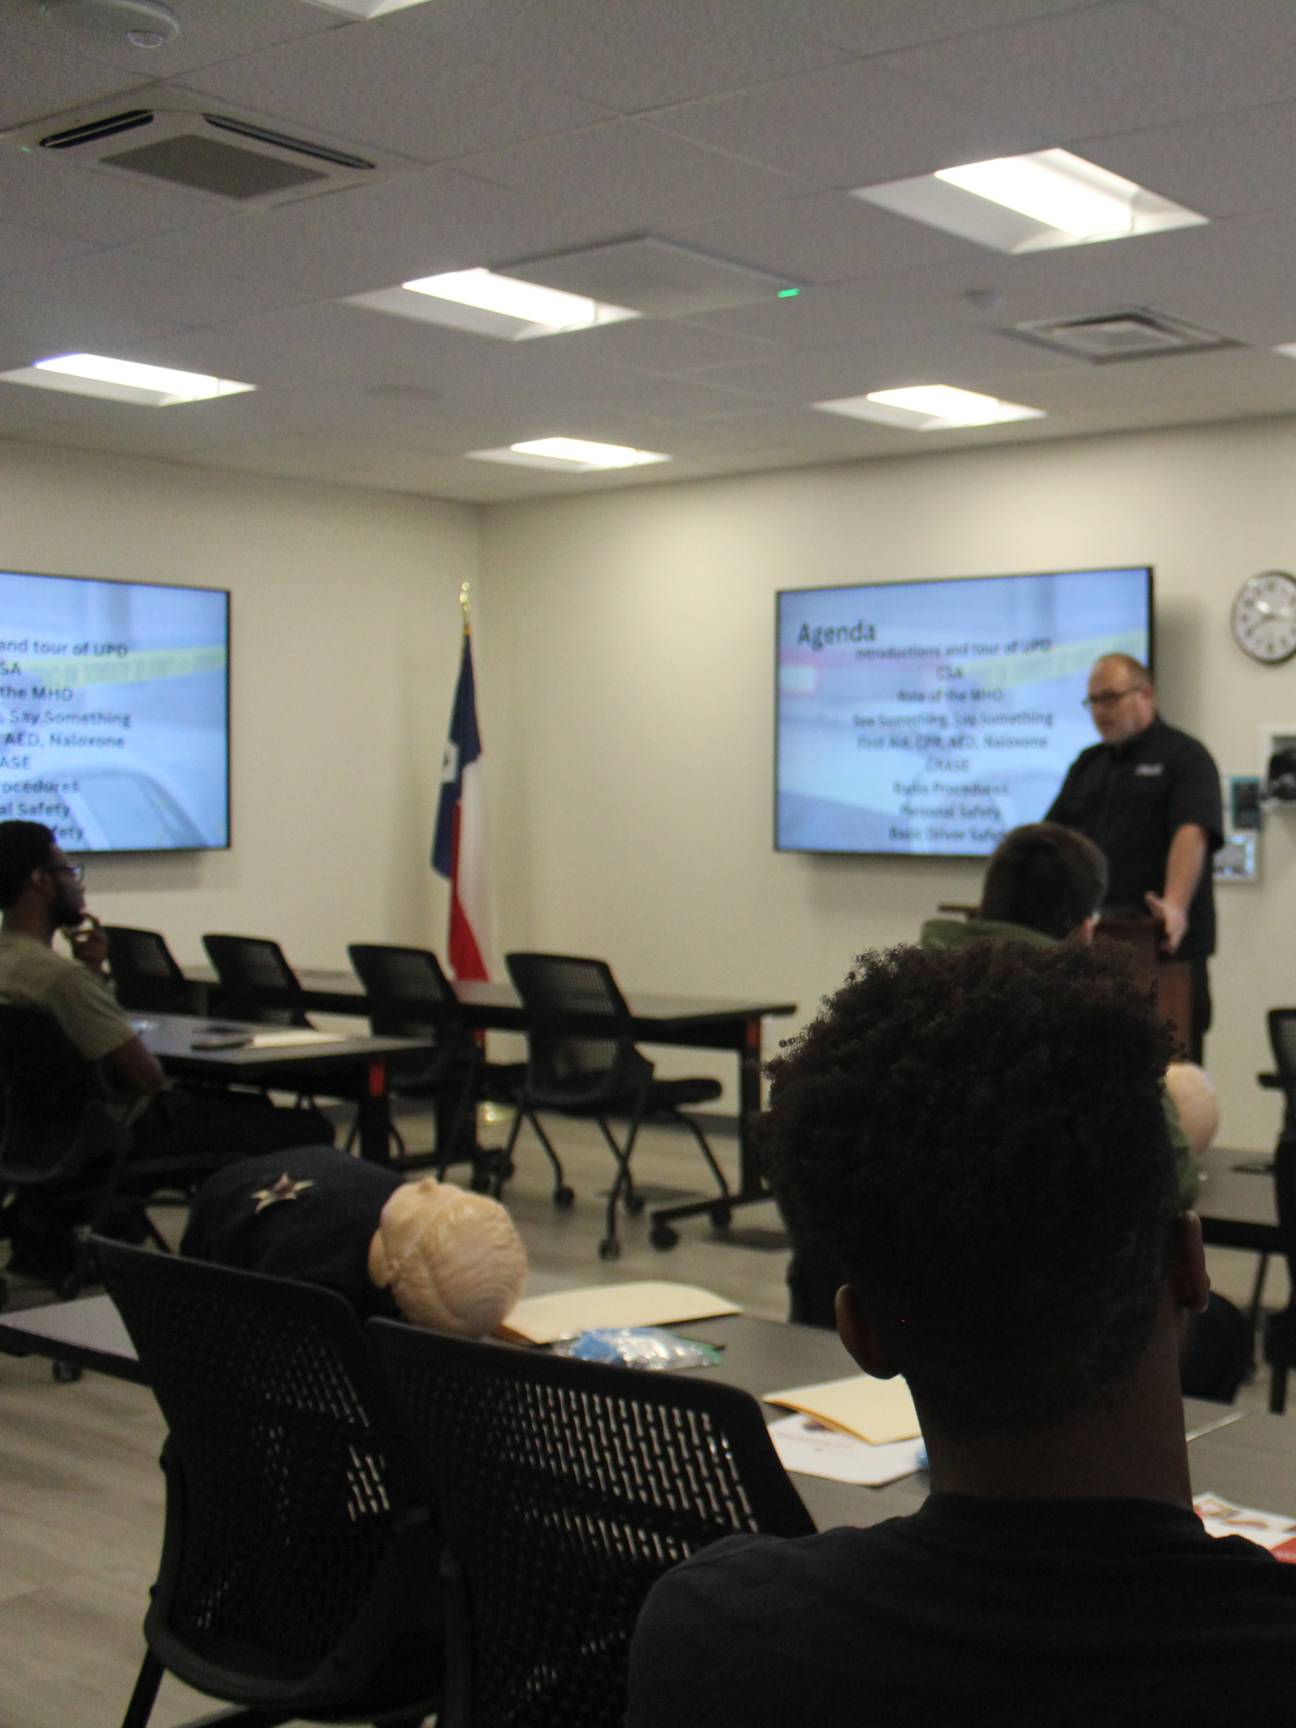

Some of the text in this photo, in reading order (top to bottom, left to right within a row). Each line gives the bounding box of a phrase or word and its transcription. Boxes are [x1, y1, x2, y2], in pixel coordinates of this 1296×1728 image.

[798, 620, 877, 651] Agenda
[33, 642, 67, 655] tour
[72, 642, 89, 655] of
[94, 643, 128, 658] UPD
[855, 646, 940, 660] Introductions
[945, 641, 968, 656] and
[972, 641, 999, 656] tour
[1004, 639, 1018, 654] of
[0, 662, 21, 674] SA
[31, 686, 73, 701] MHO
[928, 689, 942, 703] of
[945, 689, 967, 702] the
[10, 708, 131, 728] Say Something
[853, 714, 875, 727] See
[979, 711, 1053, 729] Something
[4, 732, 44, 749] AED,
[0, 756, 30, 769] ASE
[17, 803, 70, 820] Safety
[959, 803, 1002, 821] Safety
